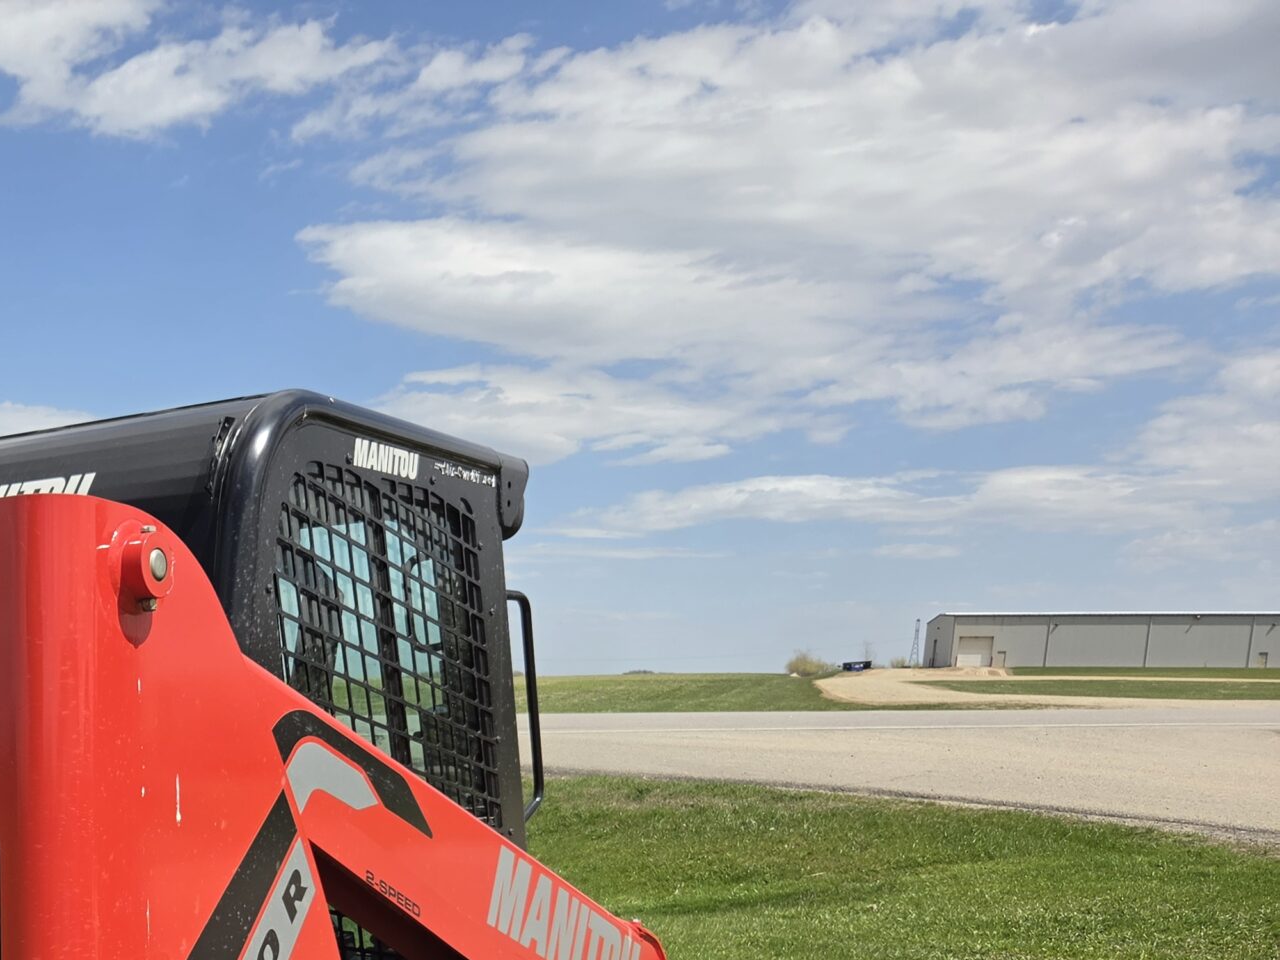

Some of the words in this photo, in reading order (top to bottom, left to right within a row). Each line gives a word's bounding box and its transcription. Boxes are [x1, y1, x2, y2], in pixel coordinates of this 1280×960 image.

[353, 437, 419, 480] MANITOU
[281, 868, 310, 925] R
[365, 869, 421, 918] 2-SPEED
